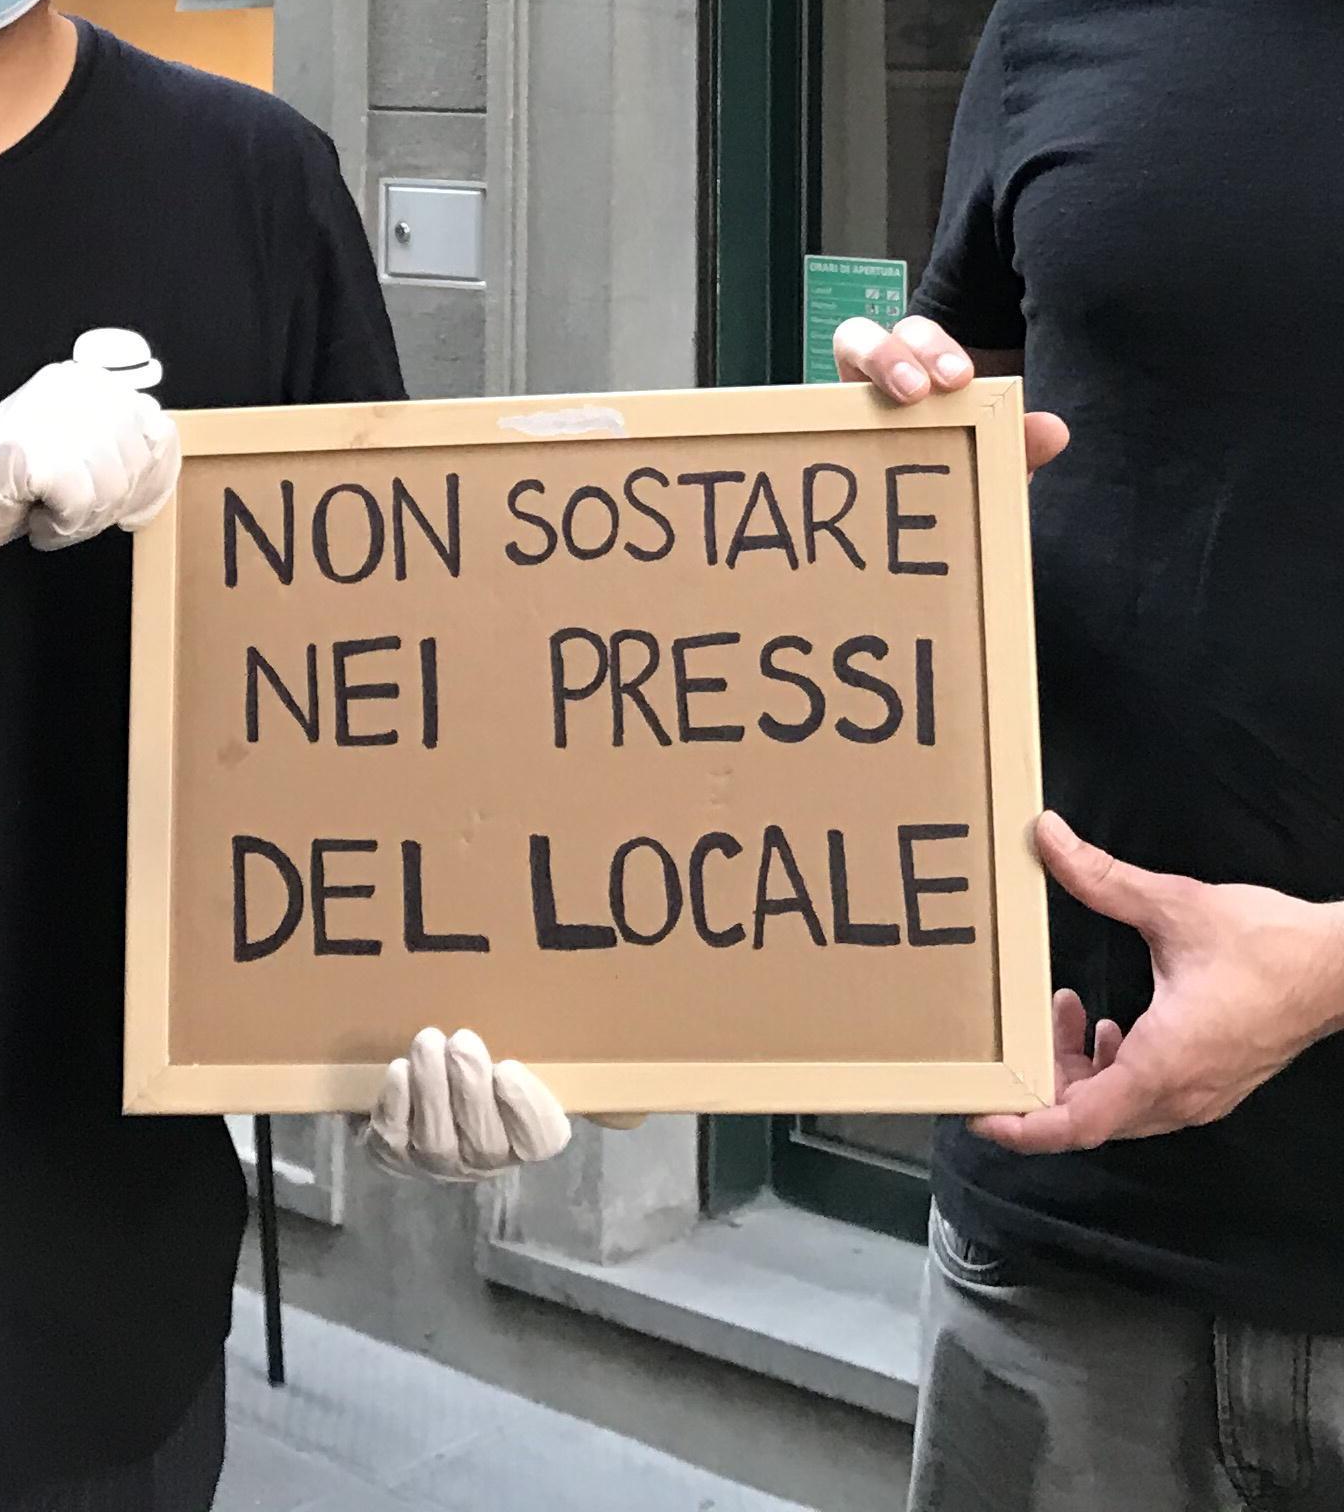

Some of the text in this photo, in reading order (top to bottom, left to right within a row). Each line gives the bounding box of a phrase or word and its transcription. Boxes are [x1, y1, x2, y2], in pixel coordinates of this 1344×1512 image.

[224, 463, 951, 588] NON SOSTARE
[244, 626, 936, 748] NEI PRESSI
[233, 823, 976, 962] DEL LOCALE
